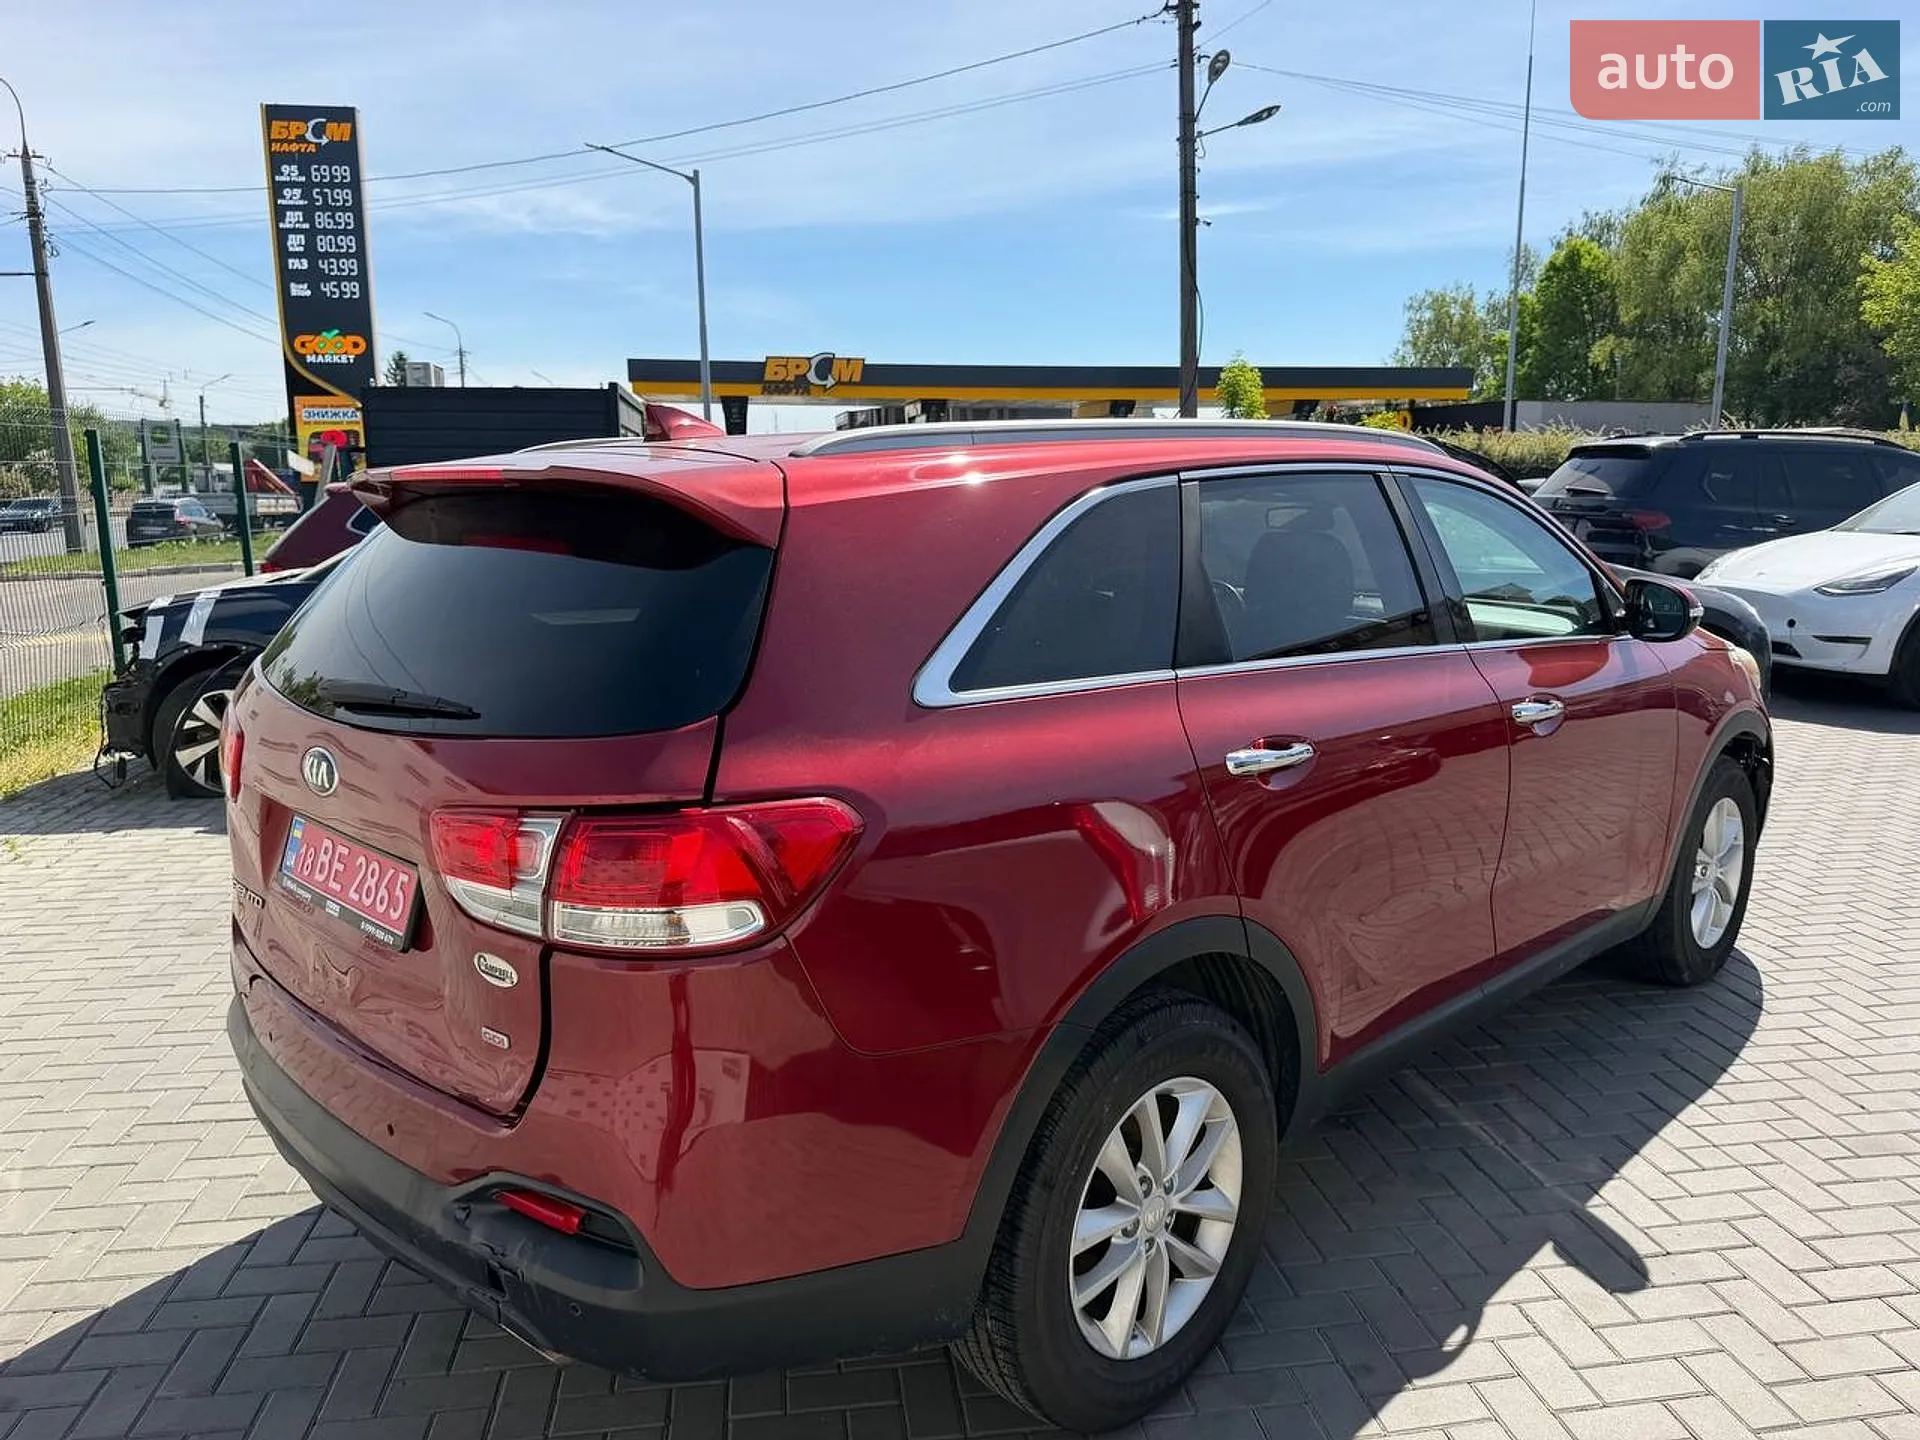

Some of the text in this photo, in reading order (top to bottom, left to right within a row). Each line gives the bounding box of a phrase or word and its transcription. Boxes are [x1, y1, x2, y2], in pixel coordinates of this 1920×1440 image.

[270, 118, 352, 146] БРСМ
[271, 142, 317, 153] НАФТА
[280, 164, 299, 177] 95
[312, 188, 353, 206] 57.99
[314, 211, 355, 229] 86.99
[316, 235, 357, 253] 80.99
[287, 258, 358, 276] ГАЗ 43.99
[294, 334, 368, 355] GOOD
[305, 354, 356, 364] MARKET
[764, 352, 866, 388] БРСМ
[303, 409, 359, 419] ЗНИЖКА
[347, 855, 410, 921] 2865
[477, 954, 516, 981] CAMPBELL
